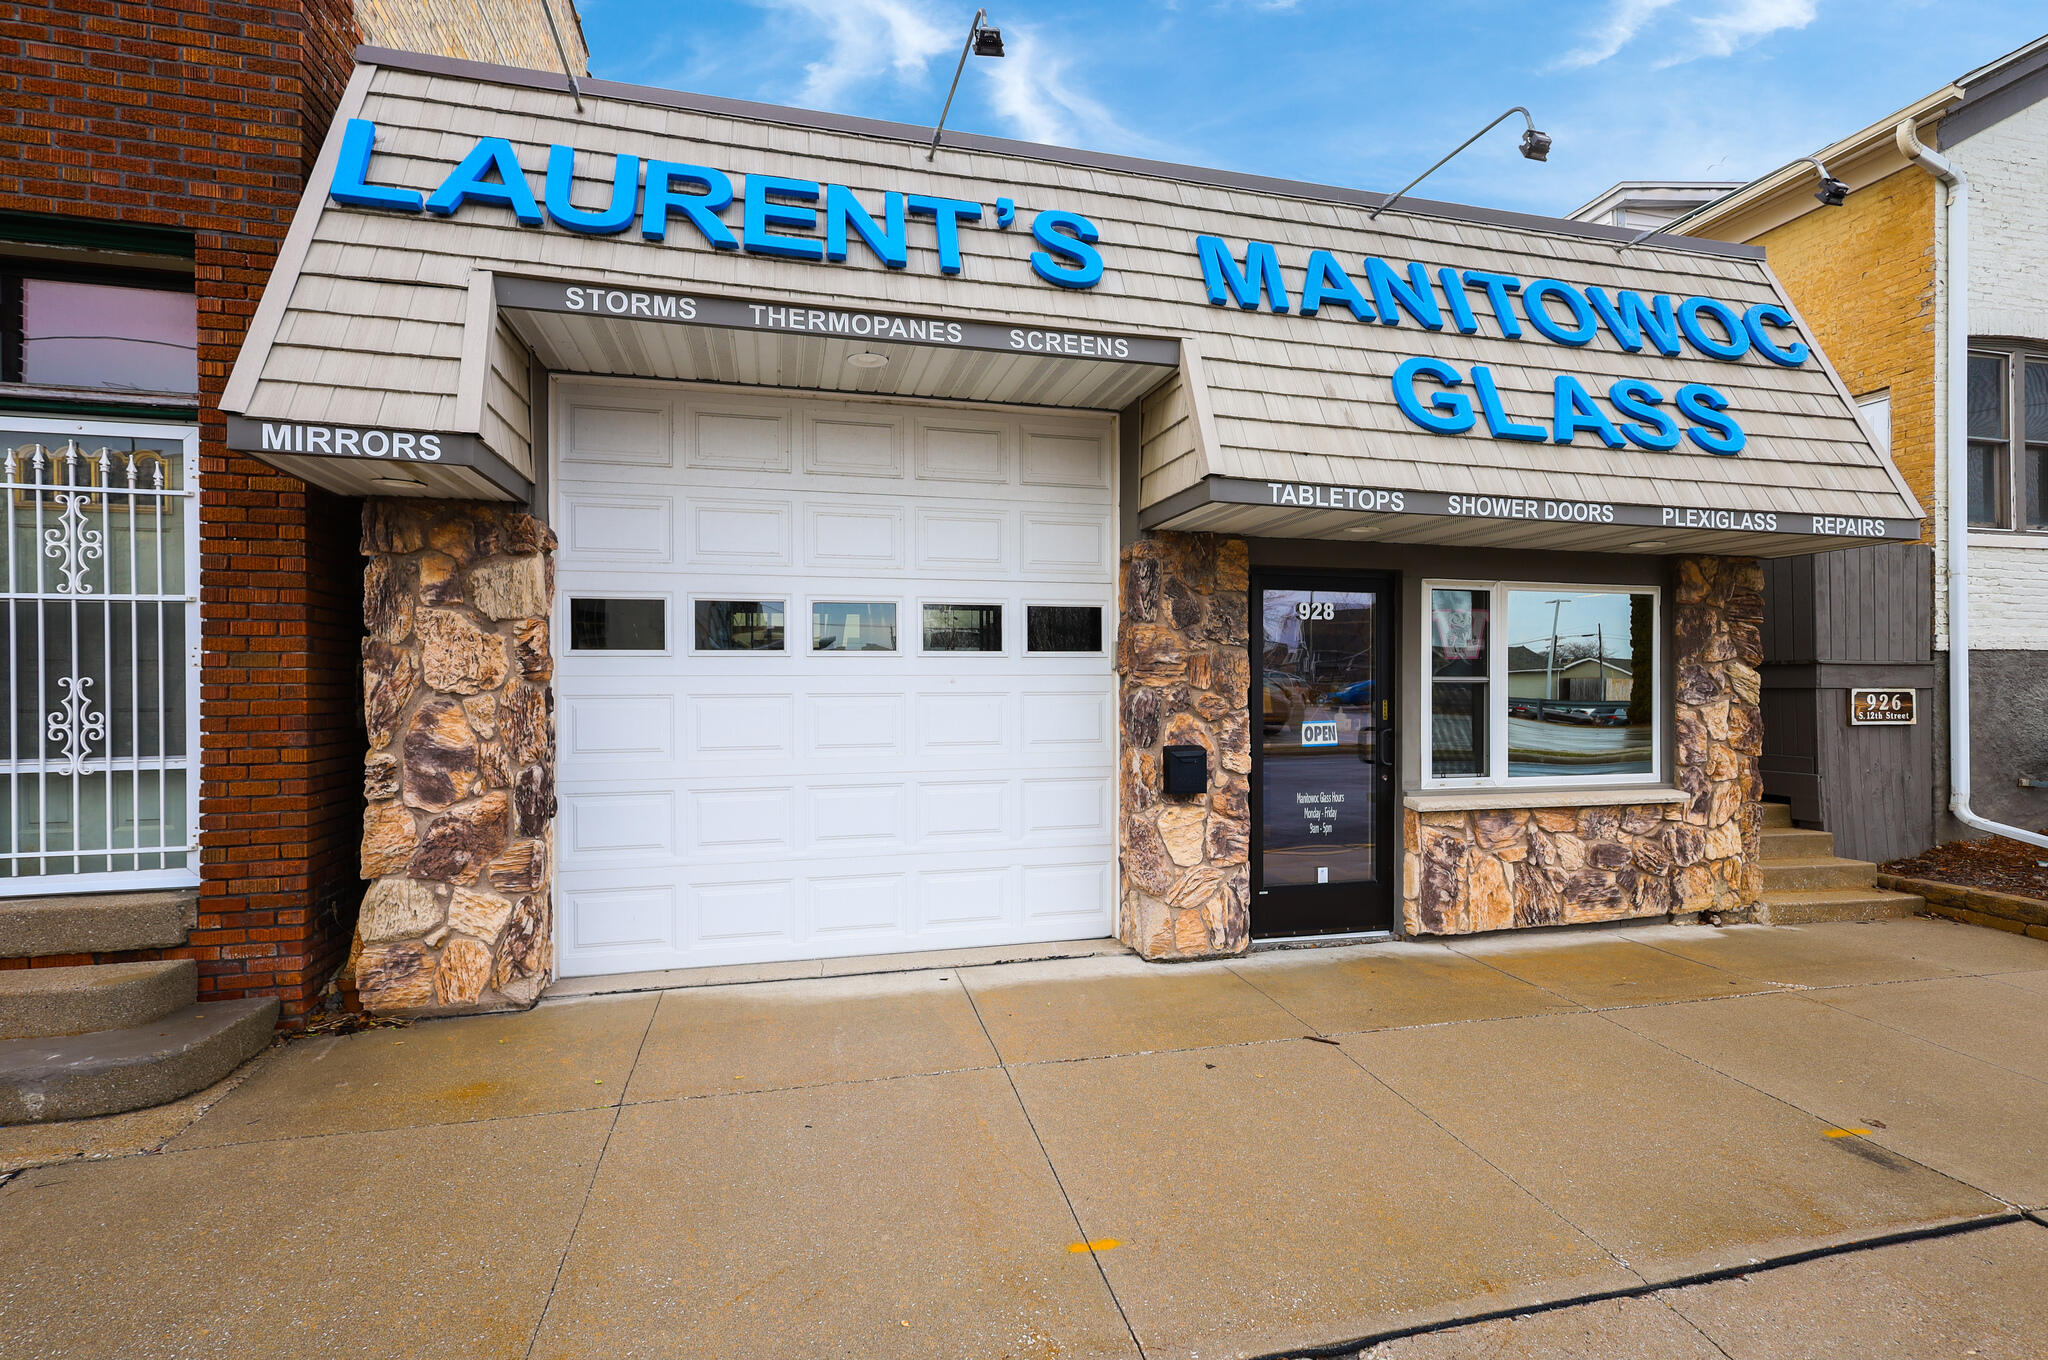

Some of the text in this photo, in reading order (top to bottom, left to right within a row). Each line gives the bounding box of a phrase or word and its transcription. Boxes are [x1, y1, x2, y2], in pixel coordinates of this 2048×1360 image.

[330, 118, 1104, 289] LAURENT'S
[1195, 235, 1809, 367] MANITOWOC
[565, 287, 1129, 358] STORMS THERMOPANES SCREENS
[1392, 357, 1746, 456] GLASS
[261, 423, 442, 461] MIRRORS
[1267, 483, 1885, 536] TABLETOPS SHOWER DOORS PLEXIGLASS REPAIRS
[1299, 602, 1335, 621] 928
[1866, 694, 1901, 711] 926
[1885, 711, 1909, 720] Street
[1304, 725, 1336, 742] OPEN
[1296, 791, 1345, 804] Manitowoc Glass Hours
[1304, 807, 1321, 822] Monday
[1324, 806, 1338, 821] Friday
